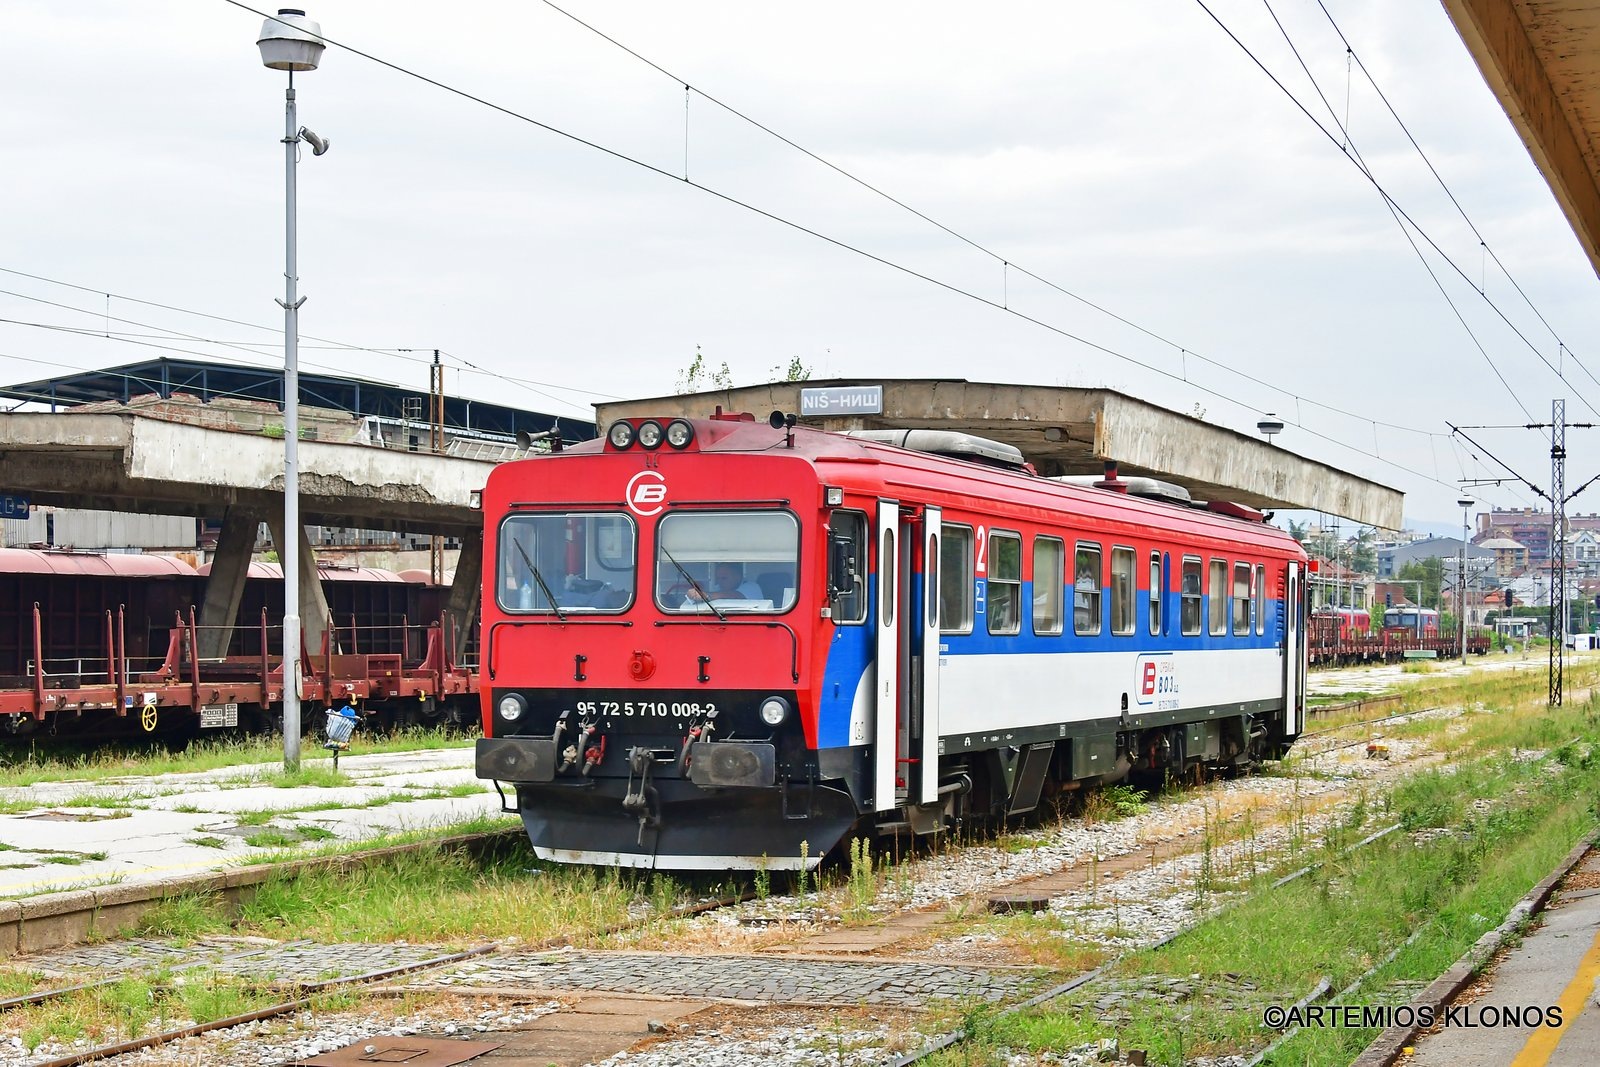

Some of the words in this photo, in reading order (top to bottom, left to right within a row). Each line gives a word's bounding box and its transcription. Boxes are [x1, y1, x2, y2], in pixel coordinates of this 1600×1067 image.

[976, 524, 985, 572] 2
[1251, 563, 1256, 595] 2
[577, 702, 597, 715] 95
[600, 703, 620, 716] 72
[624, 703, 634, 716] 5
[638, 703, 667, 717] 710
[671, 703, 716, 718] 008-2
